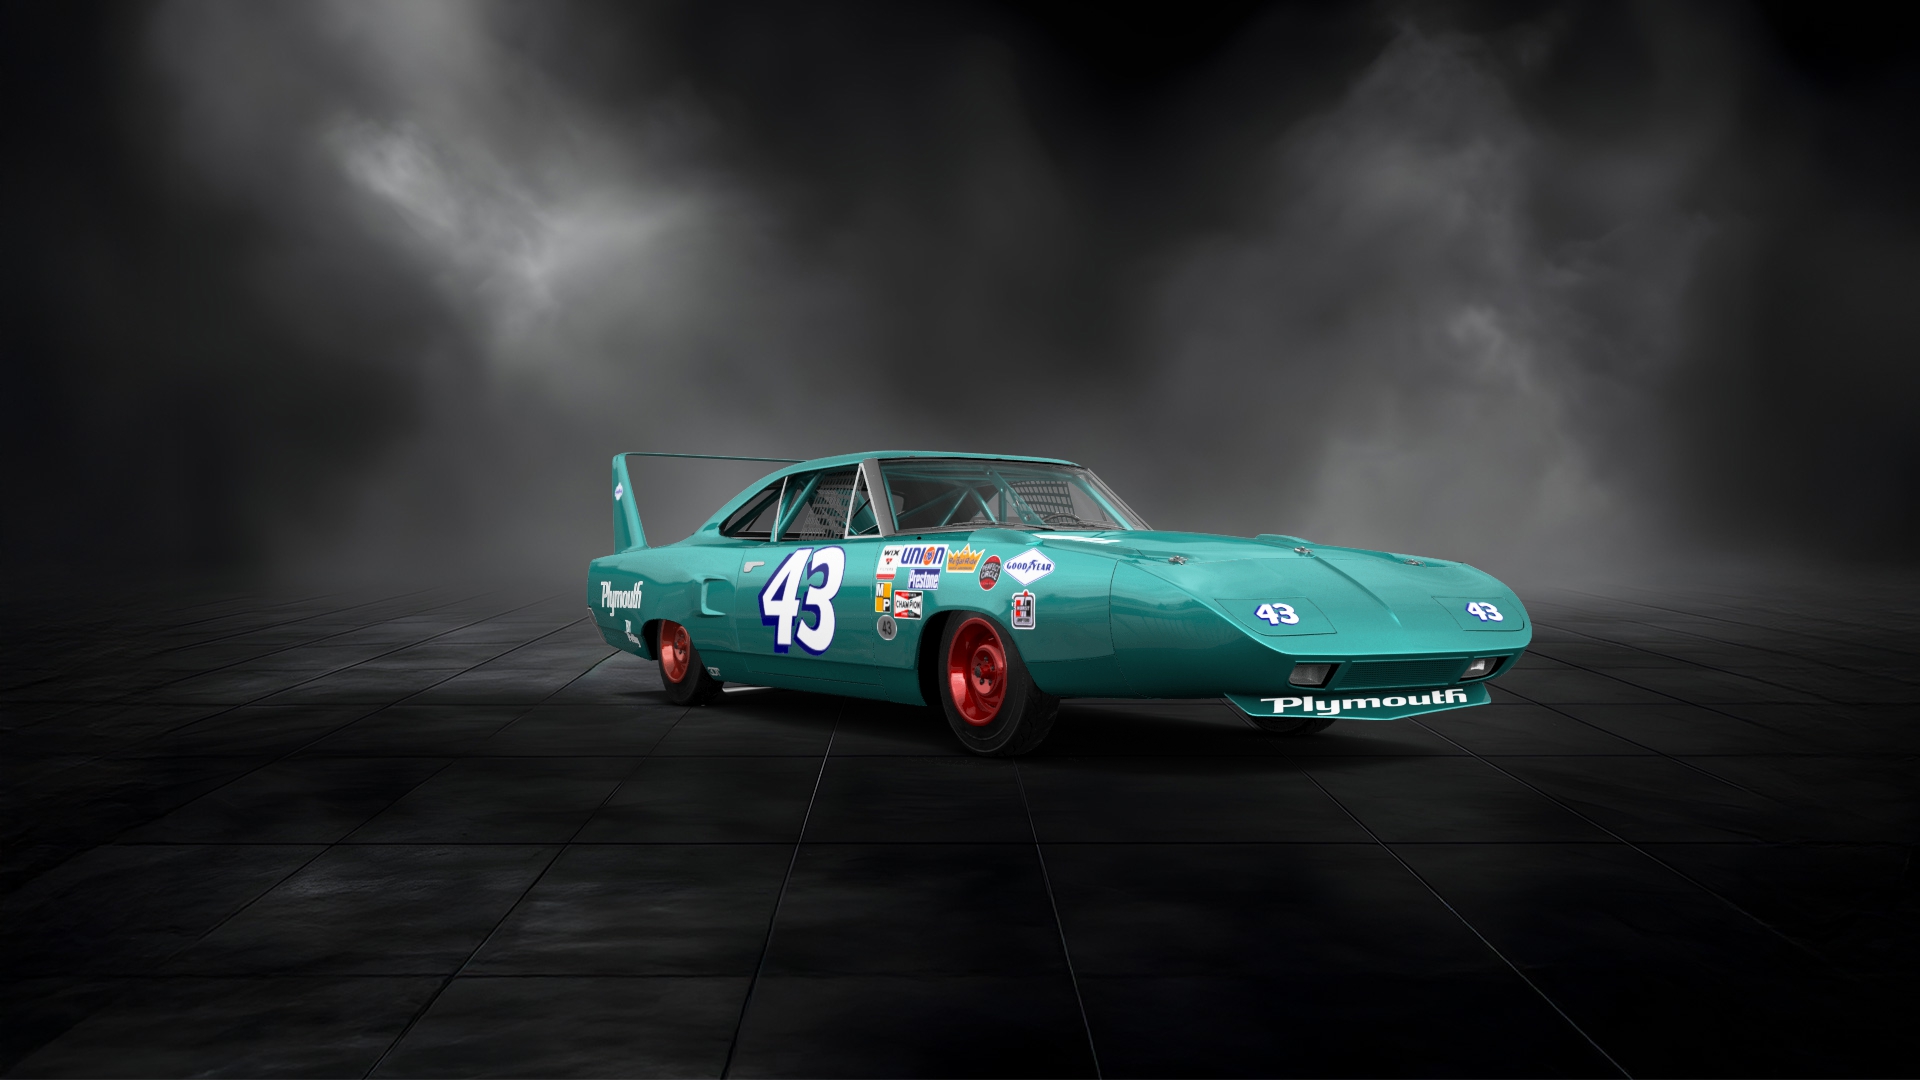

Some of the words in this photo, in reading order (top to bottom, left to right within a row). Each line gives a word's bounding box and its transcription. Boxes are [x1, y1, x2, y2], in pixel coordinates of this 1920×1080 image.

[901, 546, 945, 565] UNION
[980, 570, 998, 580] CIRCLE
[981, 562, 1001, 572] PERFECT
[907, 569, 939, 589] Prestone
[601, 581, 643, 617] Plymouth
[758, 546, 845, 655] 43
[896, 600, 921, 609] CHAMPION
[1254, 603, 1300, 626] 43
[1466, 602, 1503, 622] 43
[882, 620, 892, 635] 43
[1260, 688, 1467, 716] Plymouth
